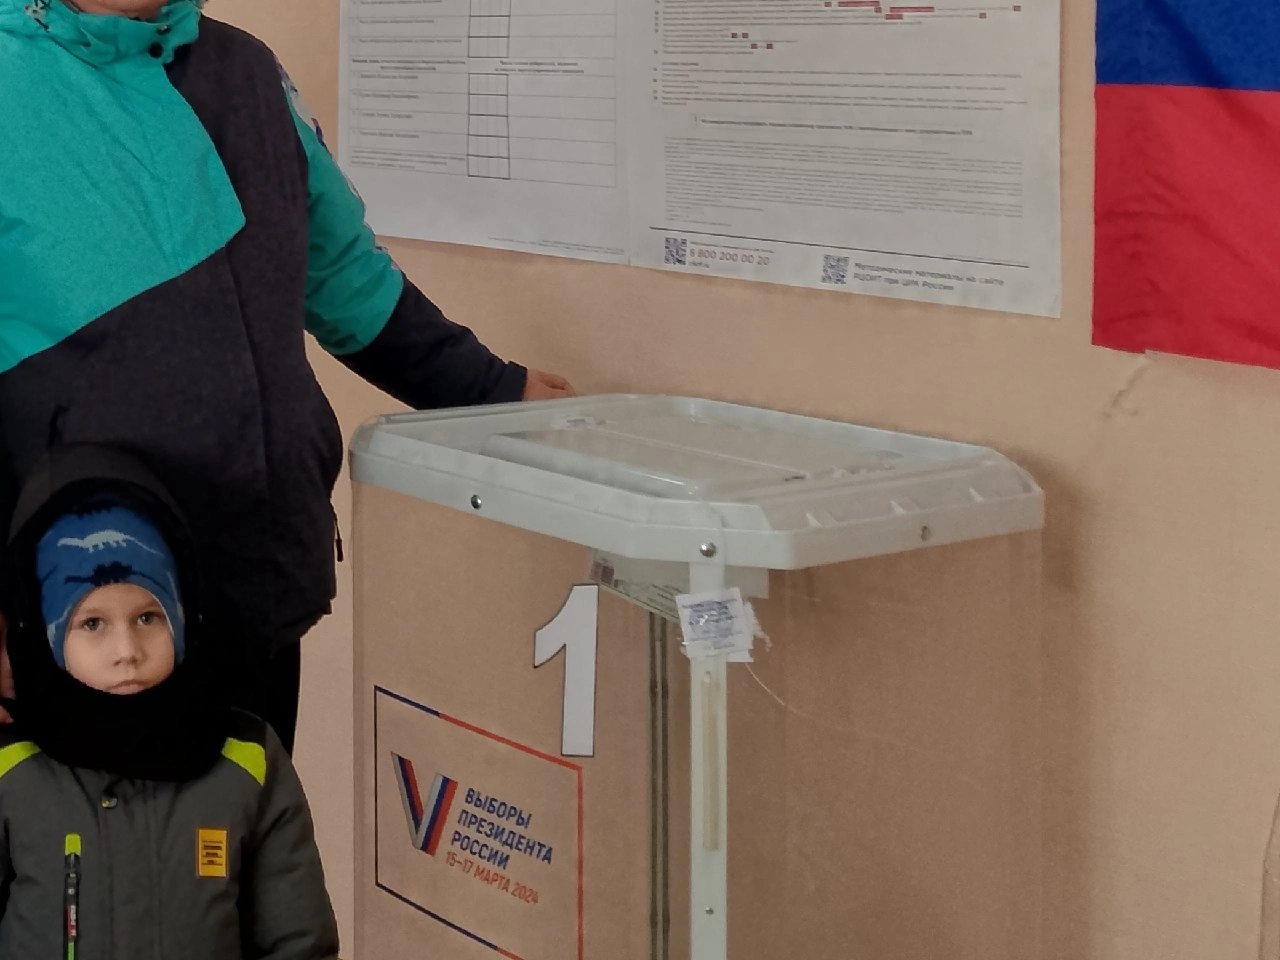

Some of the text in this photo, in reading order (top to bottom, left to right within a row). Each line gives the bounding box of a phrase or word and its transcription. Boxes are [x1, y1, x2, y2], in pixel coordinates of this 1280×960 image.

[697, 249, 717, 260] 800
[719, 251, 738, 262] 200
[740, 254, 755, 264] 00
[757, 256, 771, 265] 20
[533, 583, 599, 757] 1
[464, 787, 532, 829] ВЫБОРЫ
[451, 830, 510, 870] РОССИИ
[457, 809, 553, 865] ПРЕЗИДЕНТА
[474, 864, 511, 893] МАРТА
[511, 882, 539, 904] 2024
